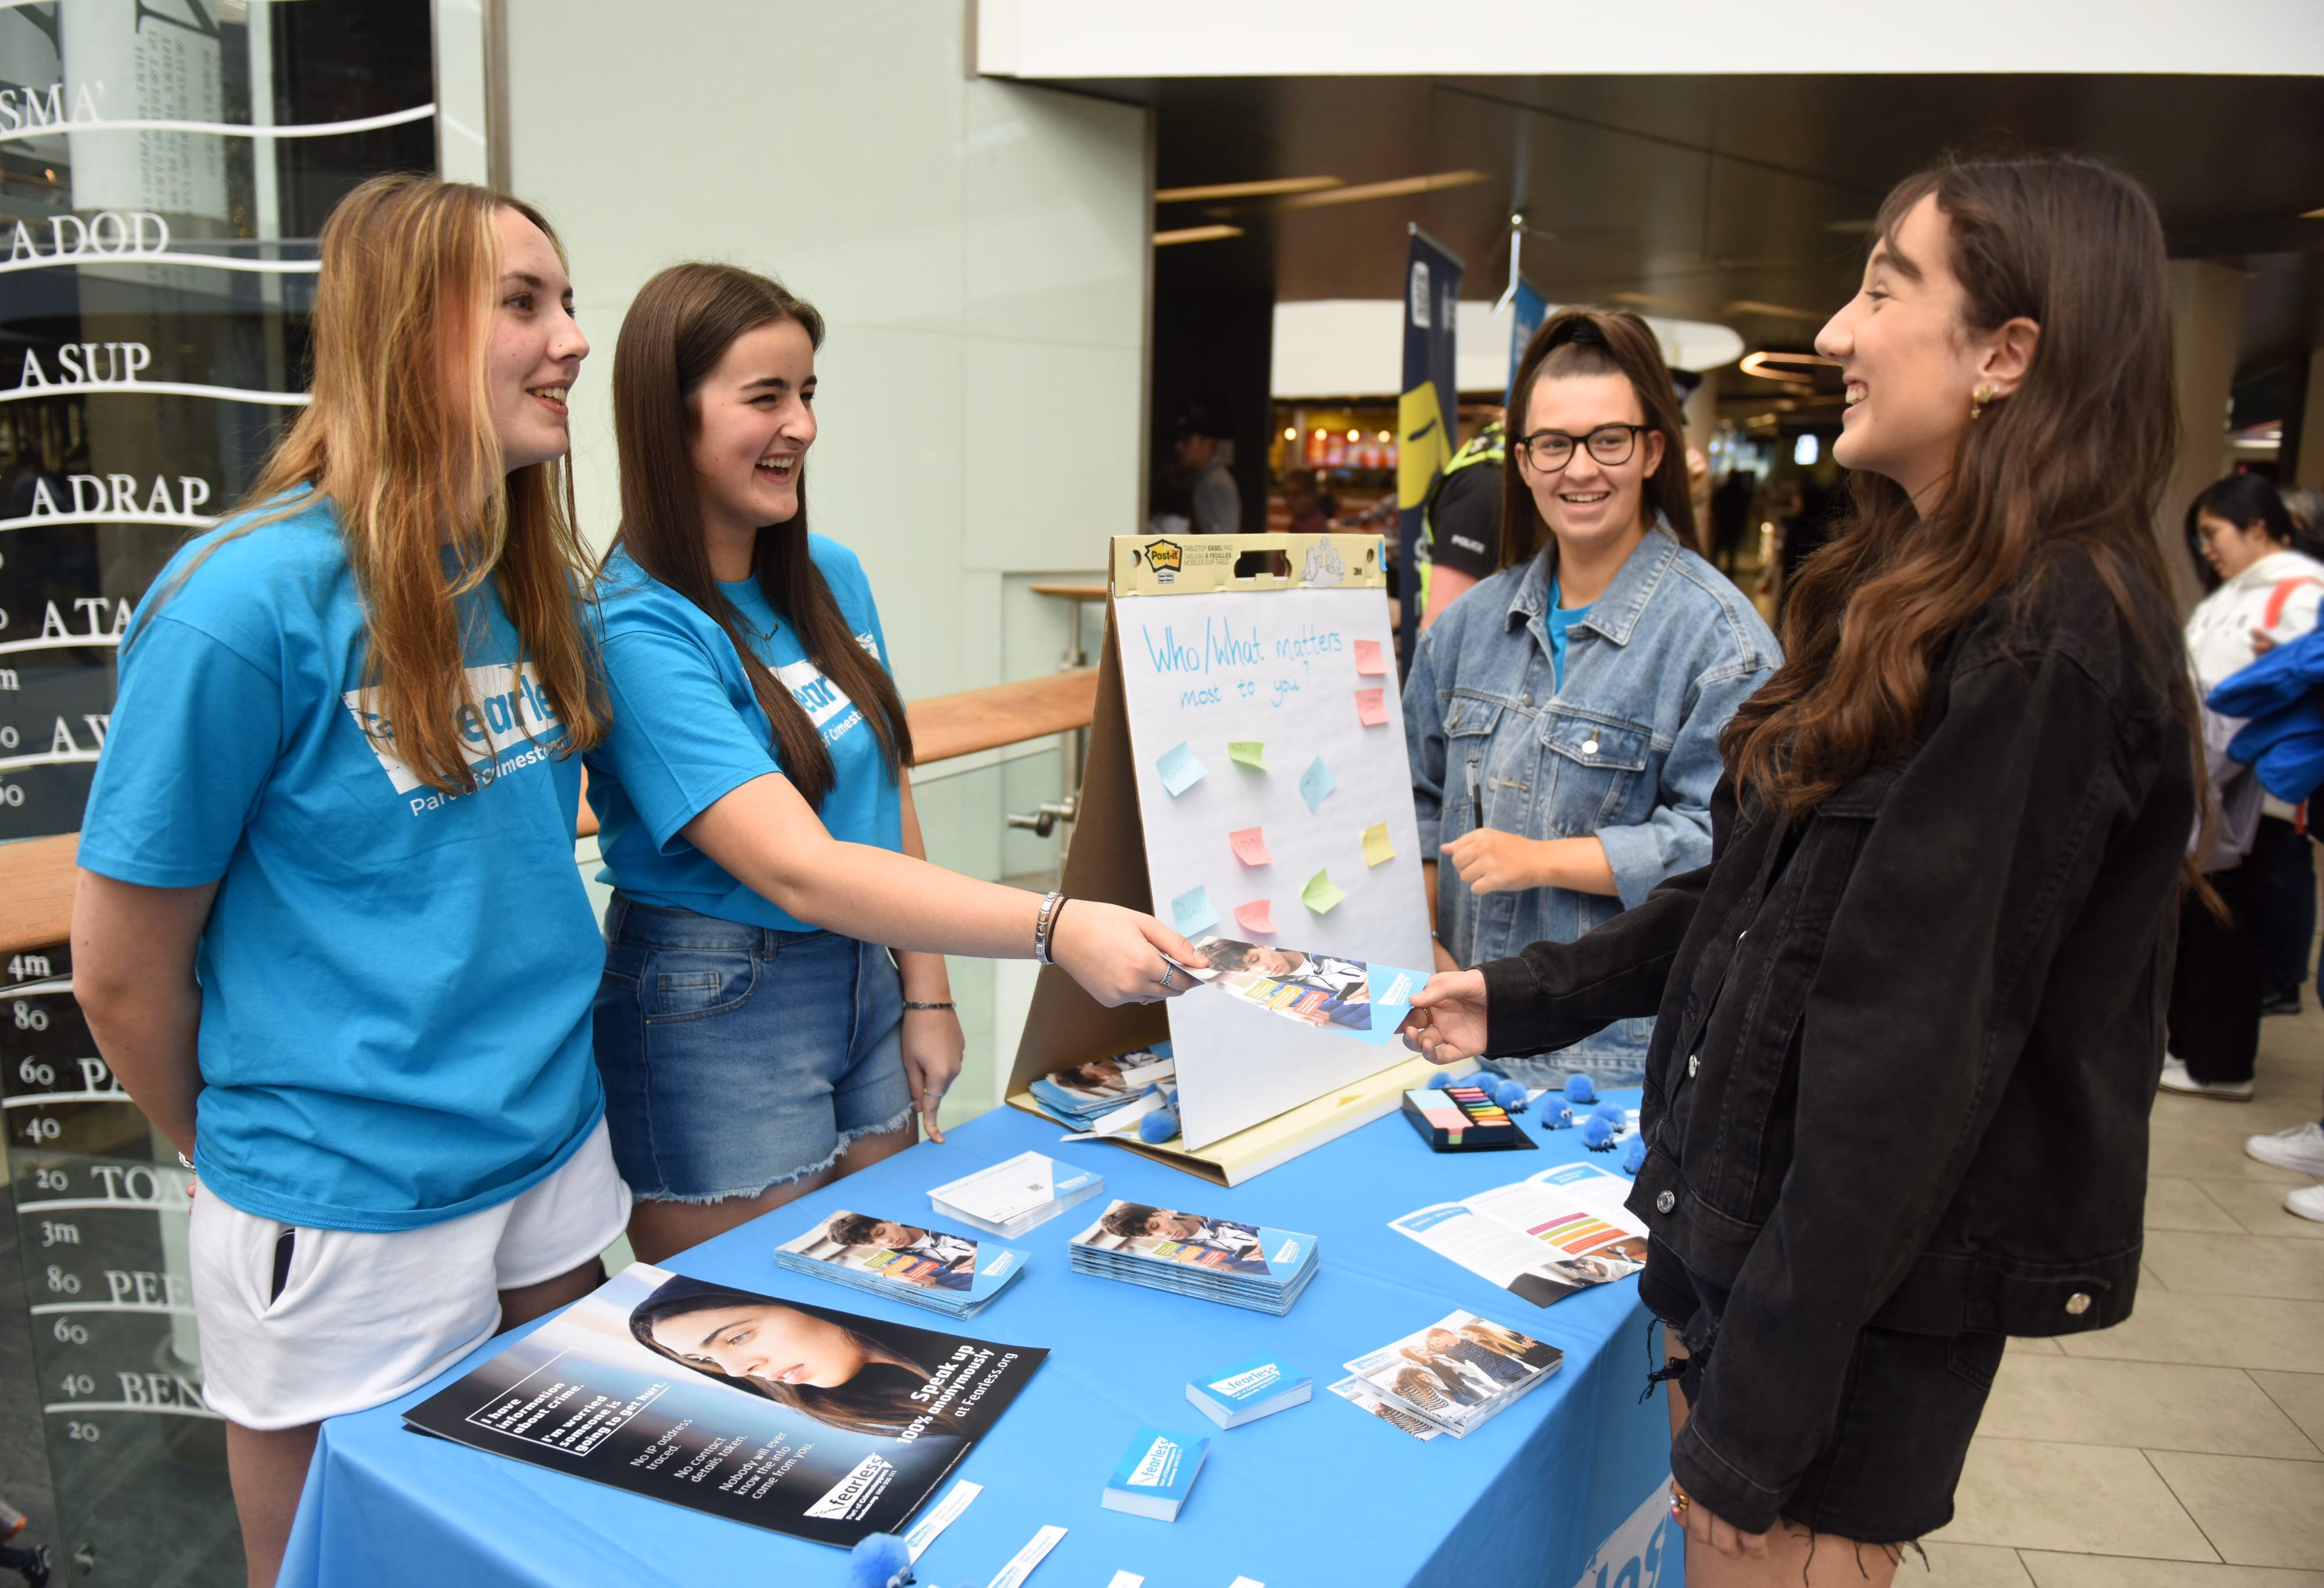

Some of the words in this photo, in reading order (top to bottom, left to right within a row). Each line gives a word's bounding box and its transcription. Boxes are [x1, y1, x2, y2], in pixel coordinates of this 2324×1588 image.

[1151, 549, 1178, 561] Post-it
[1353, 567, 1362, 576] 3M
[1276, 623, 1343, 661] matters
[1181, 682, 1222, 709] most
[1237, 674, 1256, 698] to
[8, 954, 52, 982] 4m
[13, 1000, 49, 1031] 80
[19, 1055, 56, 1086] 60
[26, 1117, 62, 1144] 40
[35, 1169, 69, 1191] 20
[41, 1221, 80, 1247] 3m
[47, 1264, 81, 1294] 80
[53, 1317, 89, 1345] 60
[62, 1374, 95, 1397] 40
[910, 1363, 959, 1403] Speak
[951, 1345, 974, 1365] up
[955, 1406, 968, 1417] at
[962, 1352, 1018, 1412] Fearless.org
[1228, 1365, 1278, 1389] fearless
[487, 1398, 522, 1420] have
[495, 1382, 565, 1430] information
[513, 1407, 550, 1434] about
[547, 1384, 584, 1409] crime.
[896, 1415, 934, 1444] 100%
[927, 1348, 995, 1414] anonymously
[68, 1421, 101, 1442] 20
[541, 1428, 566, 1443] I'm
[562, 1395, 608, 1429] worried
[559, 1409, 611, 1447] someone
[607, 1399, 622, 1413] is
[575, 1425, 611, 1453] going
[605, 1415, 622, 1428] to
[619, 1401, 642, 1417] get
[636, 1382, 666, 1402] hurt.
[630, 1452, 650, 1467] No
[644, 1445, 658, 1456] IP
[657, 1418, 693, 1447] address
[645, 1444, 682, 1470] traced.
[673, 1464, 693, 1479] No
[691, 1436, 727, 1467] contact
[691, 1456, 723, 1483] details
[723, 1435, 749, 1458] taken.
[1141, 1439, 1170, 1476] fearless
[718, 1459, 758, 1492] Nobody
[752, 1447, 770, 1463] will
[766, 1431, 787, 1449] ever
[733, 1473, 761, 1496] know
[756, 1461, 773, 1475] the
[769, 1445, 791, 1463] info
[752, 1477, 779, 1500] came
[773, 1458, 798, 1479] from
[793, 1442, 815, 1461] you.
[829, 1458, 884, 1506] fearless
[845, 1508, 859, 1520] Part
[859, 1468, 890, 1504] Crimestoppers
